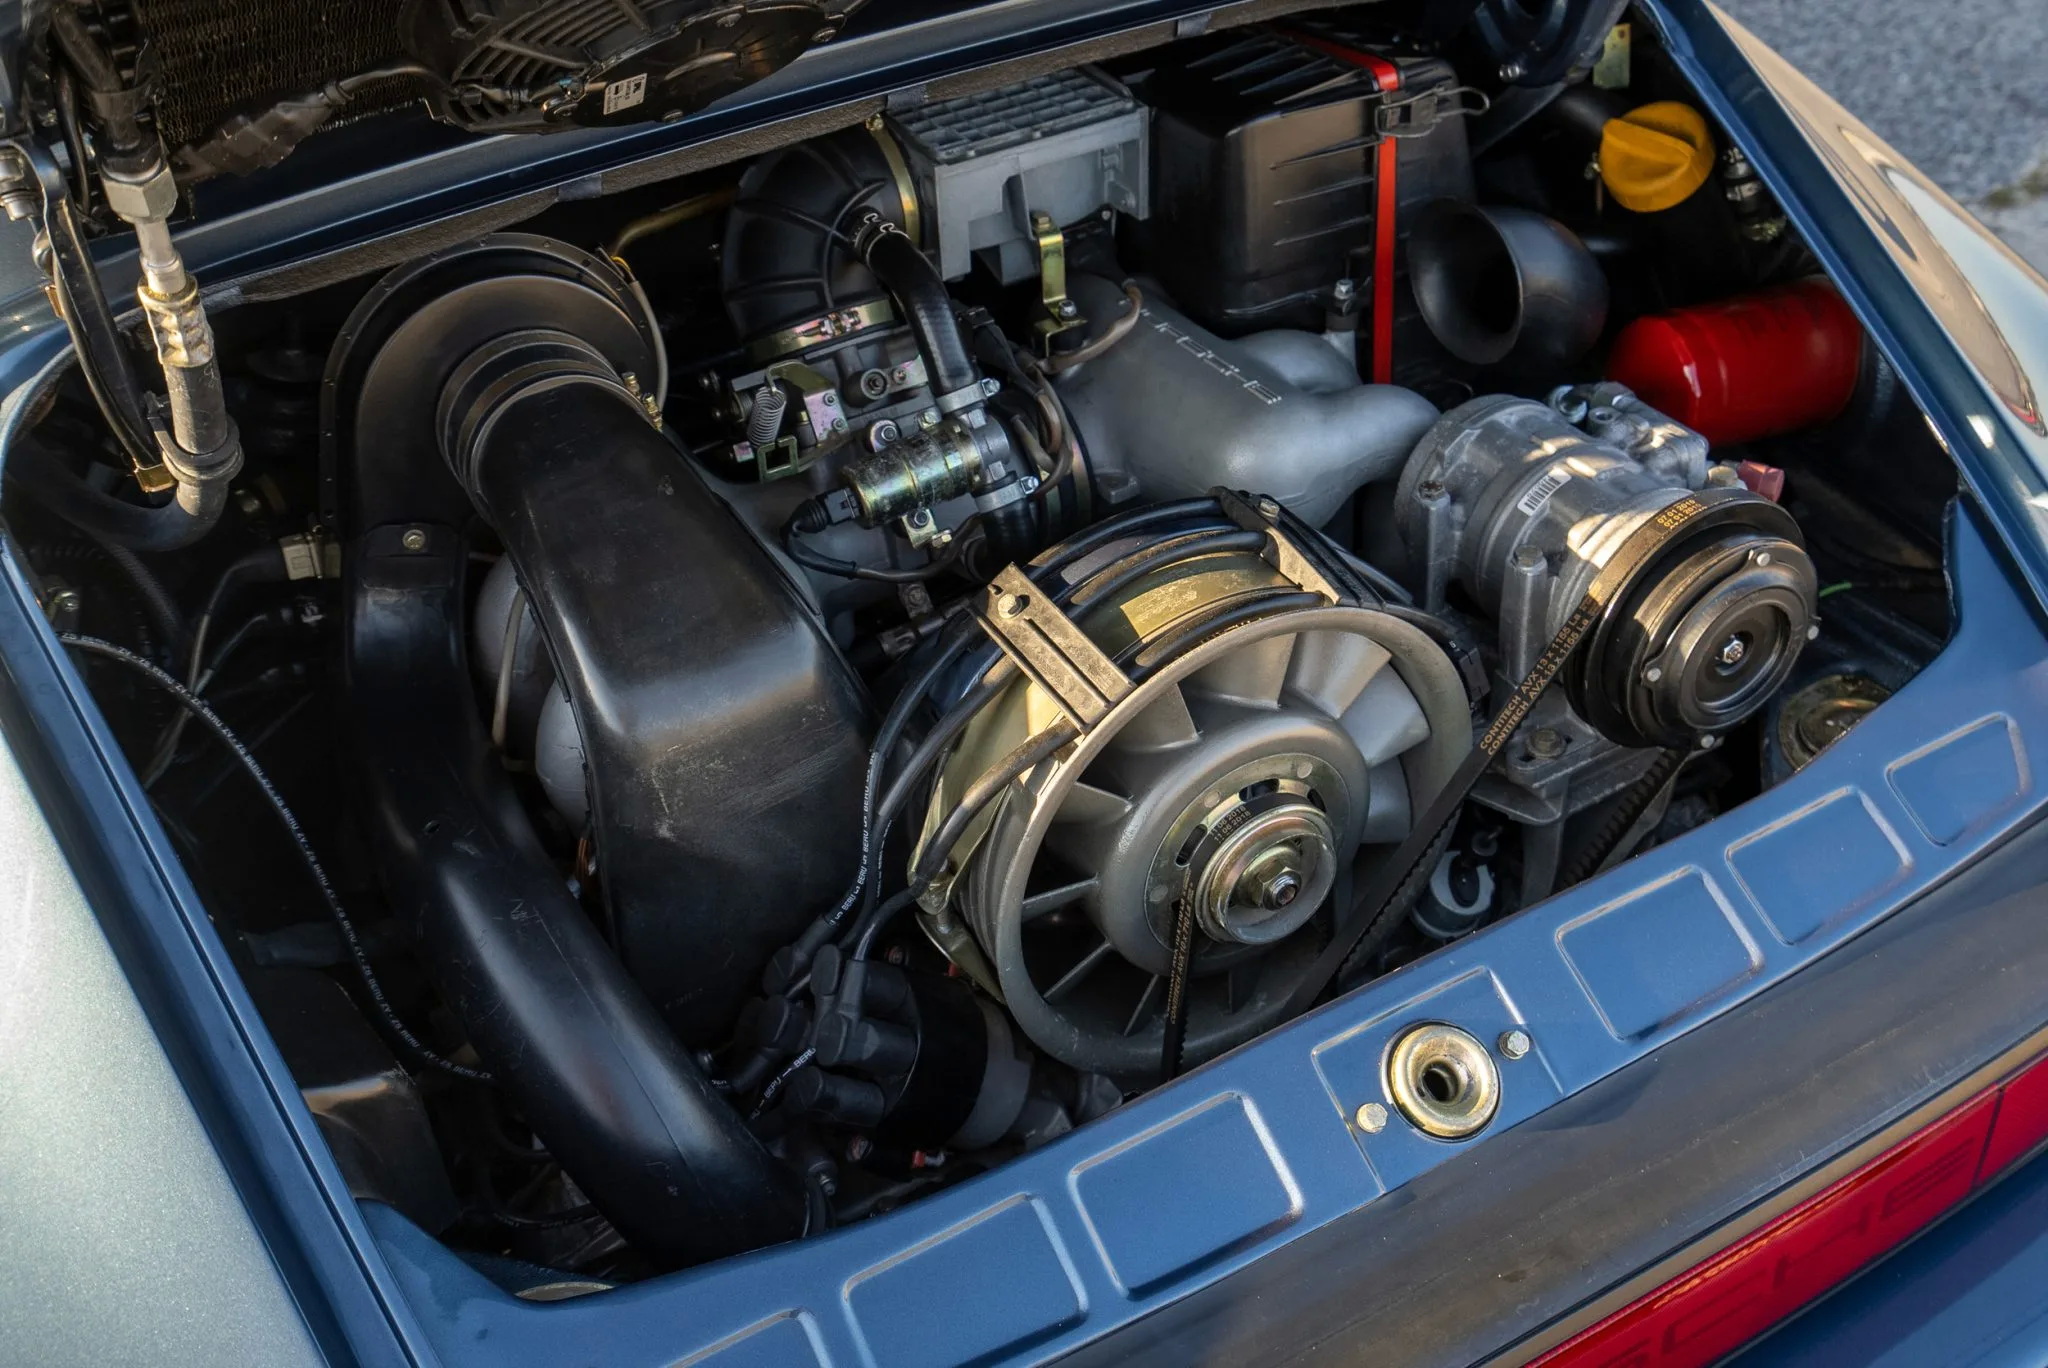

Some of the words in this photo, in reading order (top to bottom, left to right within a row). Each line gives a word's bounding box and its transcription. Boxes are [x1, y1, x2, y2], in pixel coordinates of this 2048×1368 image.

[1480, 695, 1521, 749] CONTITECH
[1521, 671, 1539, 694] AVX
[1536, 658, 1548, 670] 13
[1487, 700, 1529, 755] CONTITECH
[1529, 675, 1546, 700] AVX
[1545, 663, 1556, 676] 13
[841, 894, 857, 911] BERU
[857, 866, 868, 885] BERU
[793, 1047, 817, 1068] BERU
